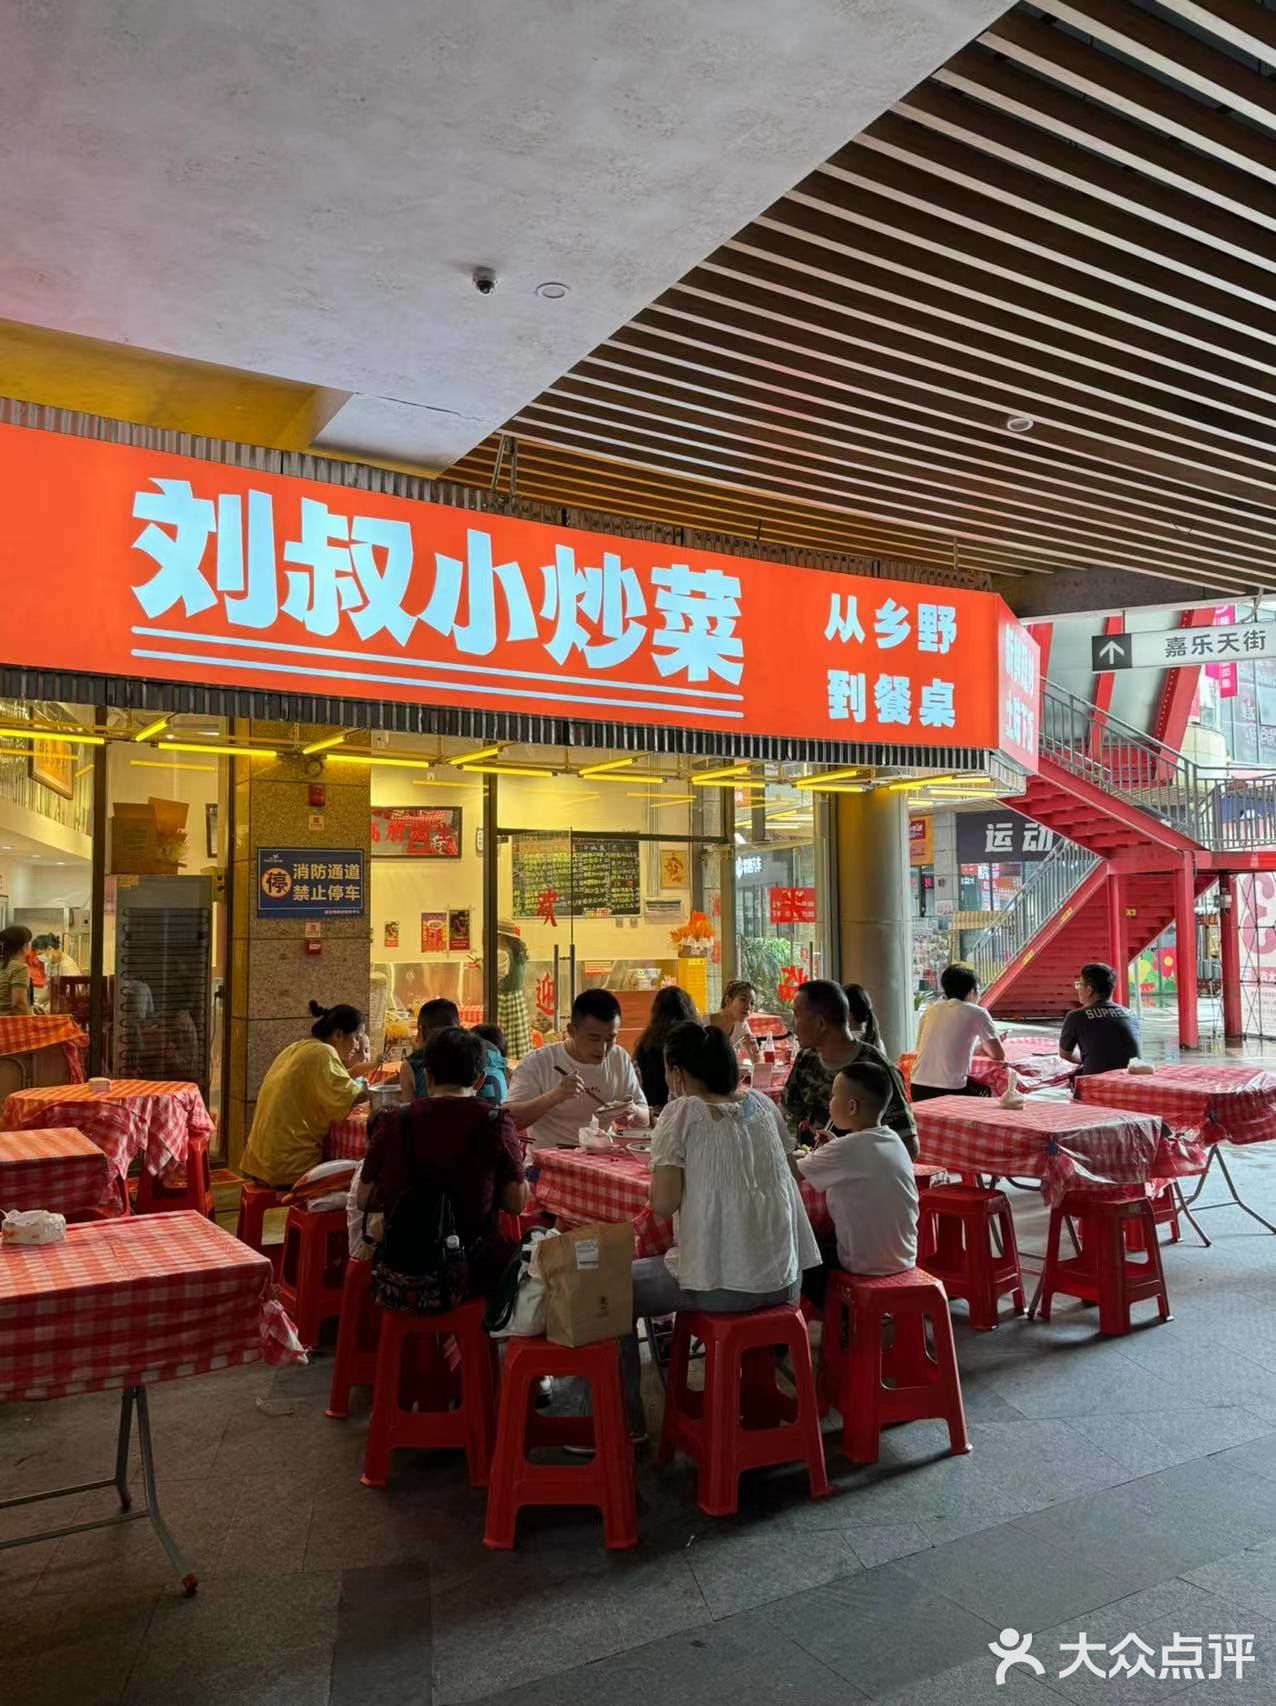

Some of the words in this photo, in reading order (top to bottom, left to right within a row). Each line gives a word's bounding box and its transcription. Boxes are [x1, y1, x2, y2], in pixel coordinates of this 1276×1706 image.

[132, 478, 744, 686] 刘叔小炒菜
[825, 593, 957, 654] 从乡野
[1165, 629, 1267, 658] 嘉乐天街
[827, 669, 956, 728] 到餐桌
[984, 823, 1070, 854] 运动
[293, 863, 361, 880] 消防通道
[293, 885, 361, 901] 禁止停车
